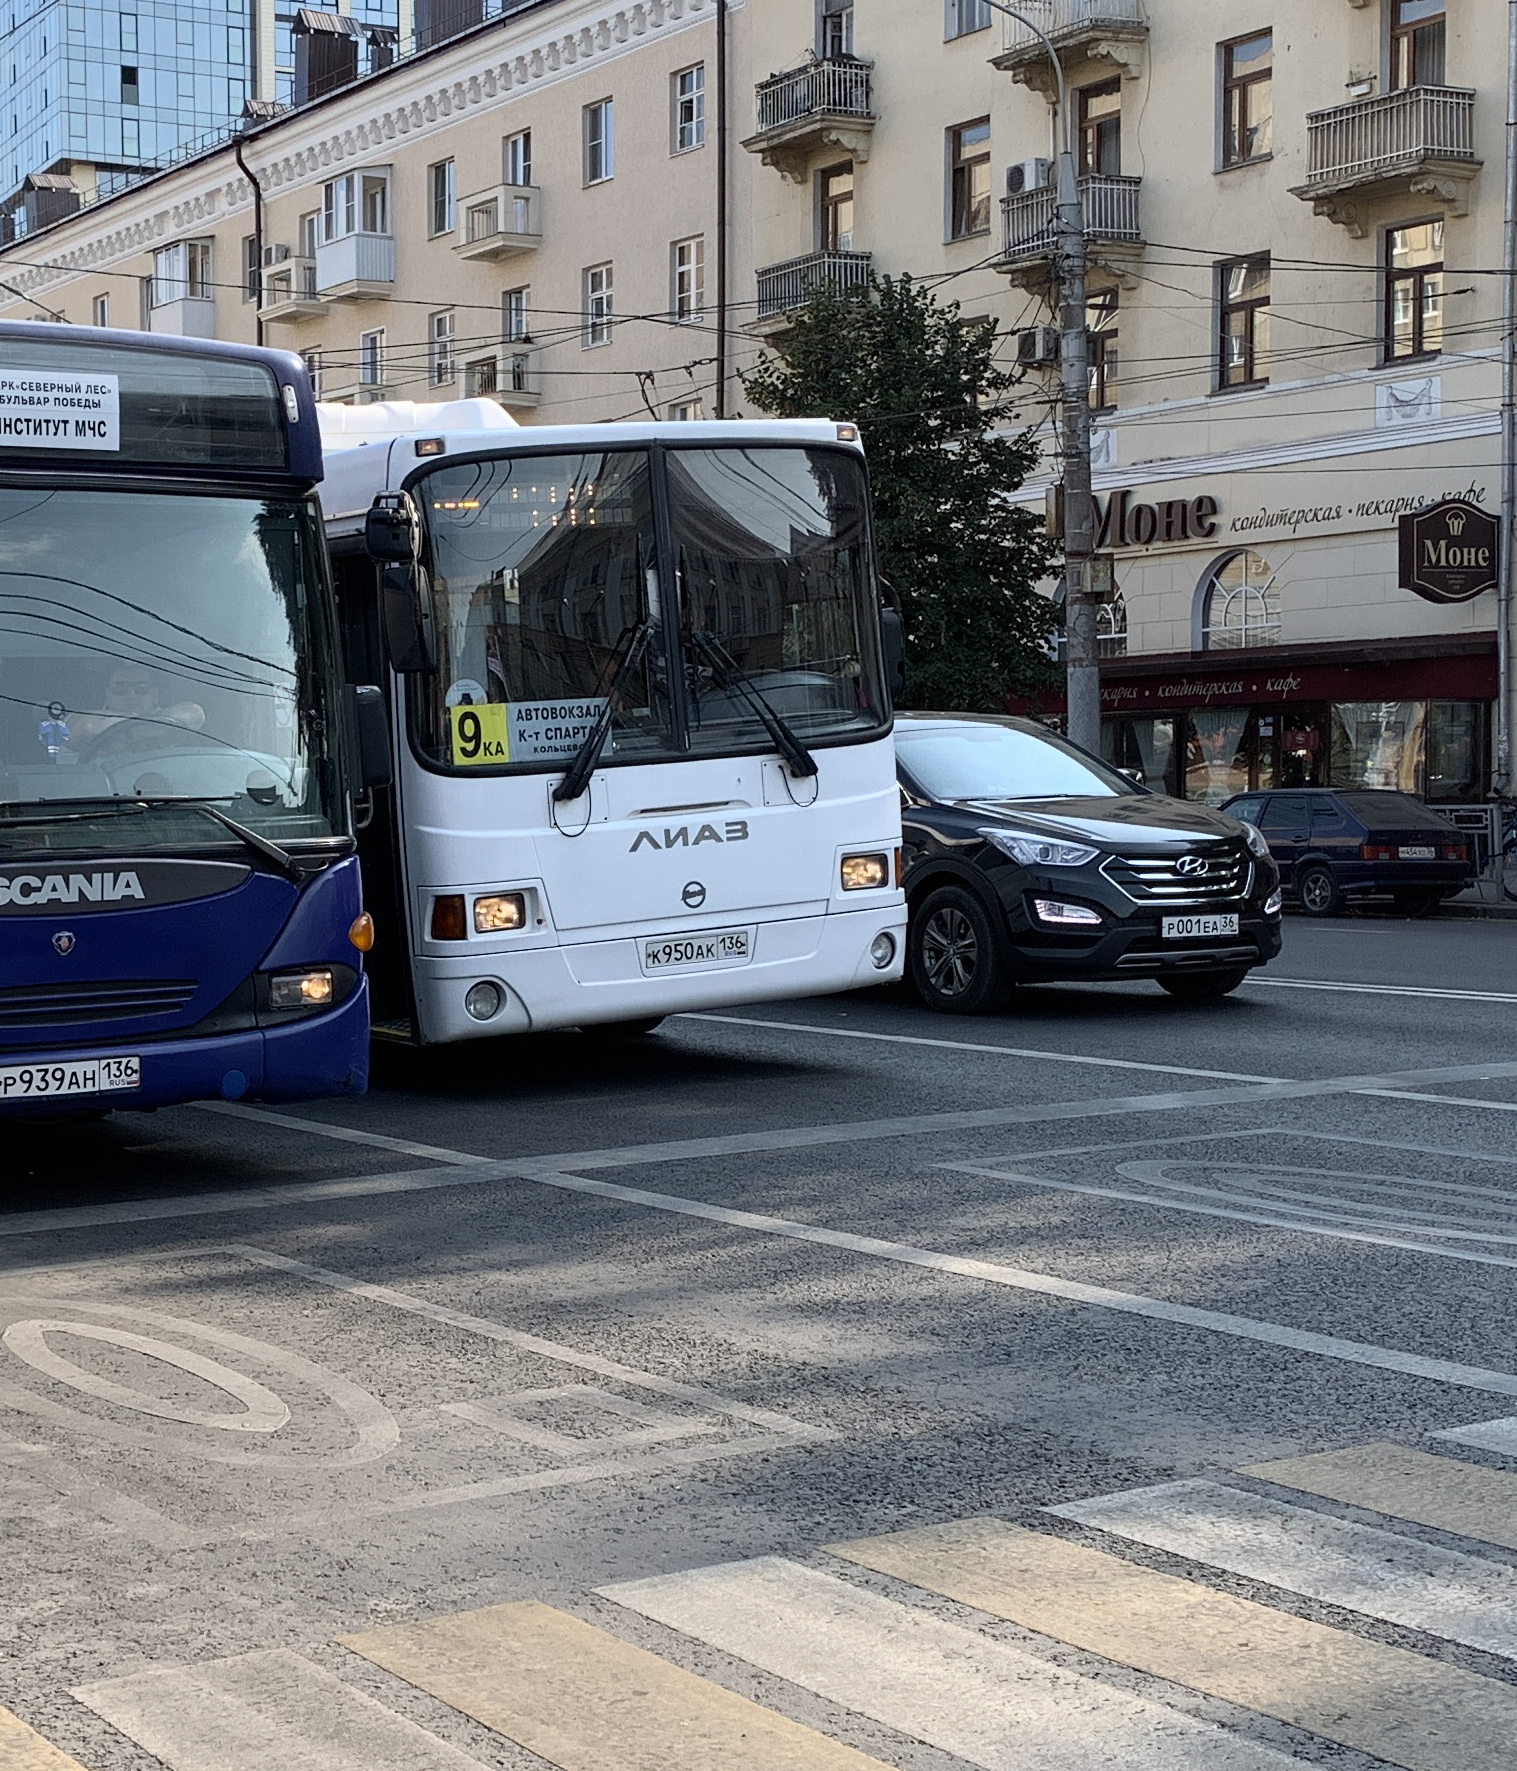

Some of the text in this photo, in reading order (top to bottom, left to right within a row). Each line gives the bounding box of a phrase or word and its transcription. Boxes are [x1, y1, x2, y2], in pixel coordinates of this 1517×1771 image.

[0, 395, 101, 410] БУЛЬВАР ПОБЕДЫ
[75, 420, 107, 438] МЧС
[1230, 504, 1344, 534] кондитерская
[1423, 539, 1490, 567] Моне
[1157, 679, 1244, 703] кондитерская
[1265, 672, 1302, 699] кафе
[516, 704, 601, 722] АВТОВОКЗАЛ
[629, 820, 749, 853] ЛИАЗ
[1167, 916, 1234, 935] Р001ЕА 36
[652, 935, 744, 965] К950АК 136
[3, 1059, 134, 1095] Р939АН 136
[109, 1078, 126, 1087] RUS
